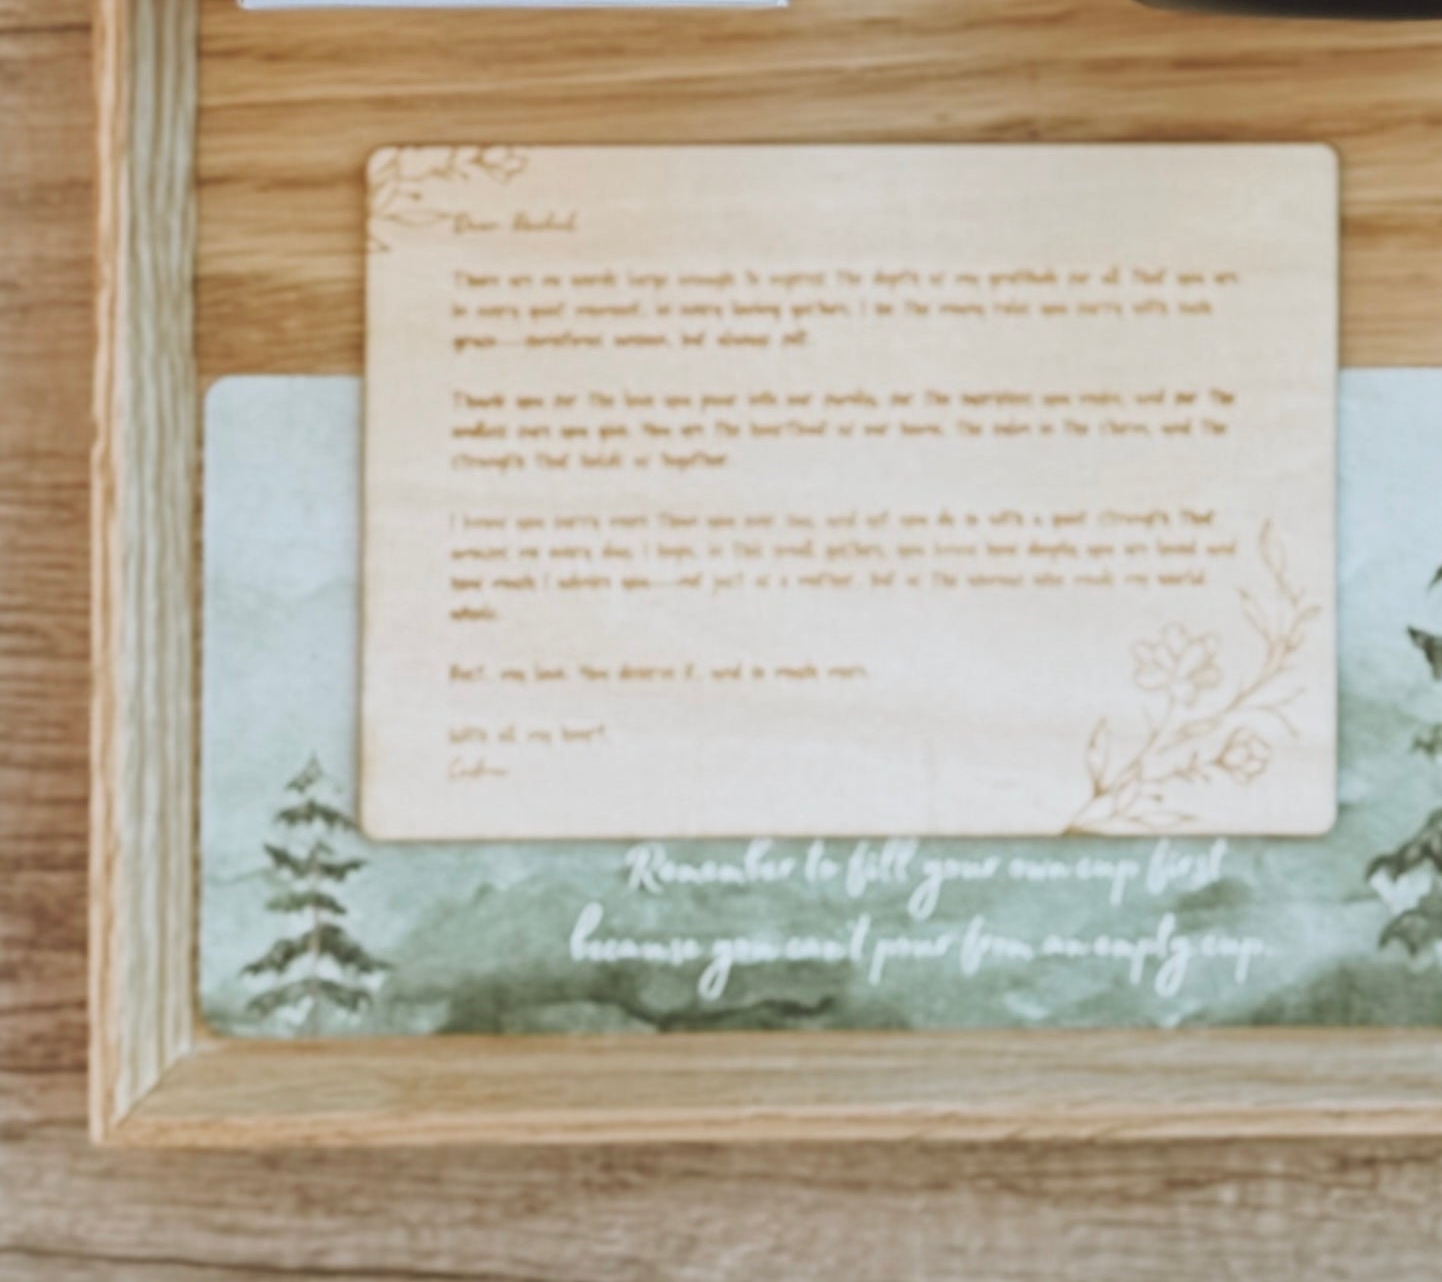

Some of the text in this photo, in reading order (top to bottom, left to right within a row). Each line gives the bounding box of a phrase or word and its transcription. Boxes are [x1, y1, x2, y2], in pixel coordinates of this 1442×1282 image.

[624, 838, 794, 894] Remember
[804, 839, 839, 883] to
[846, 838, 918, 899] fill
[907, 856, 1002, 922] your
[1074, 856, 1140, 907] cup
[697, 936, 782, 1002] you
[960, 914, 1035, 977] from
